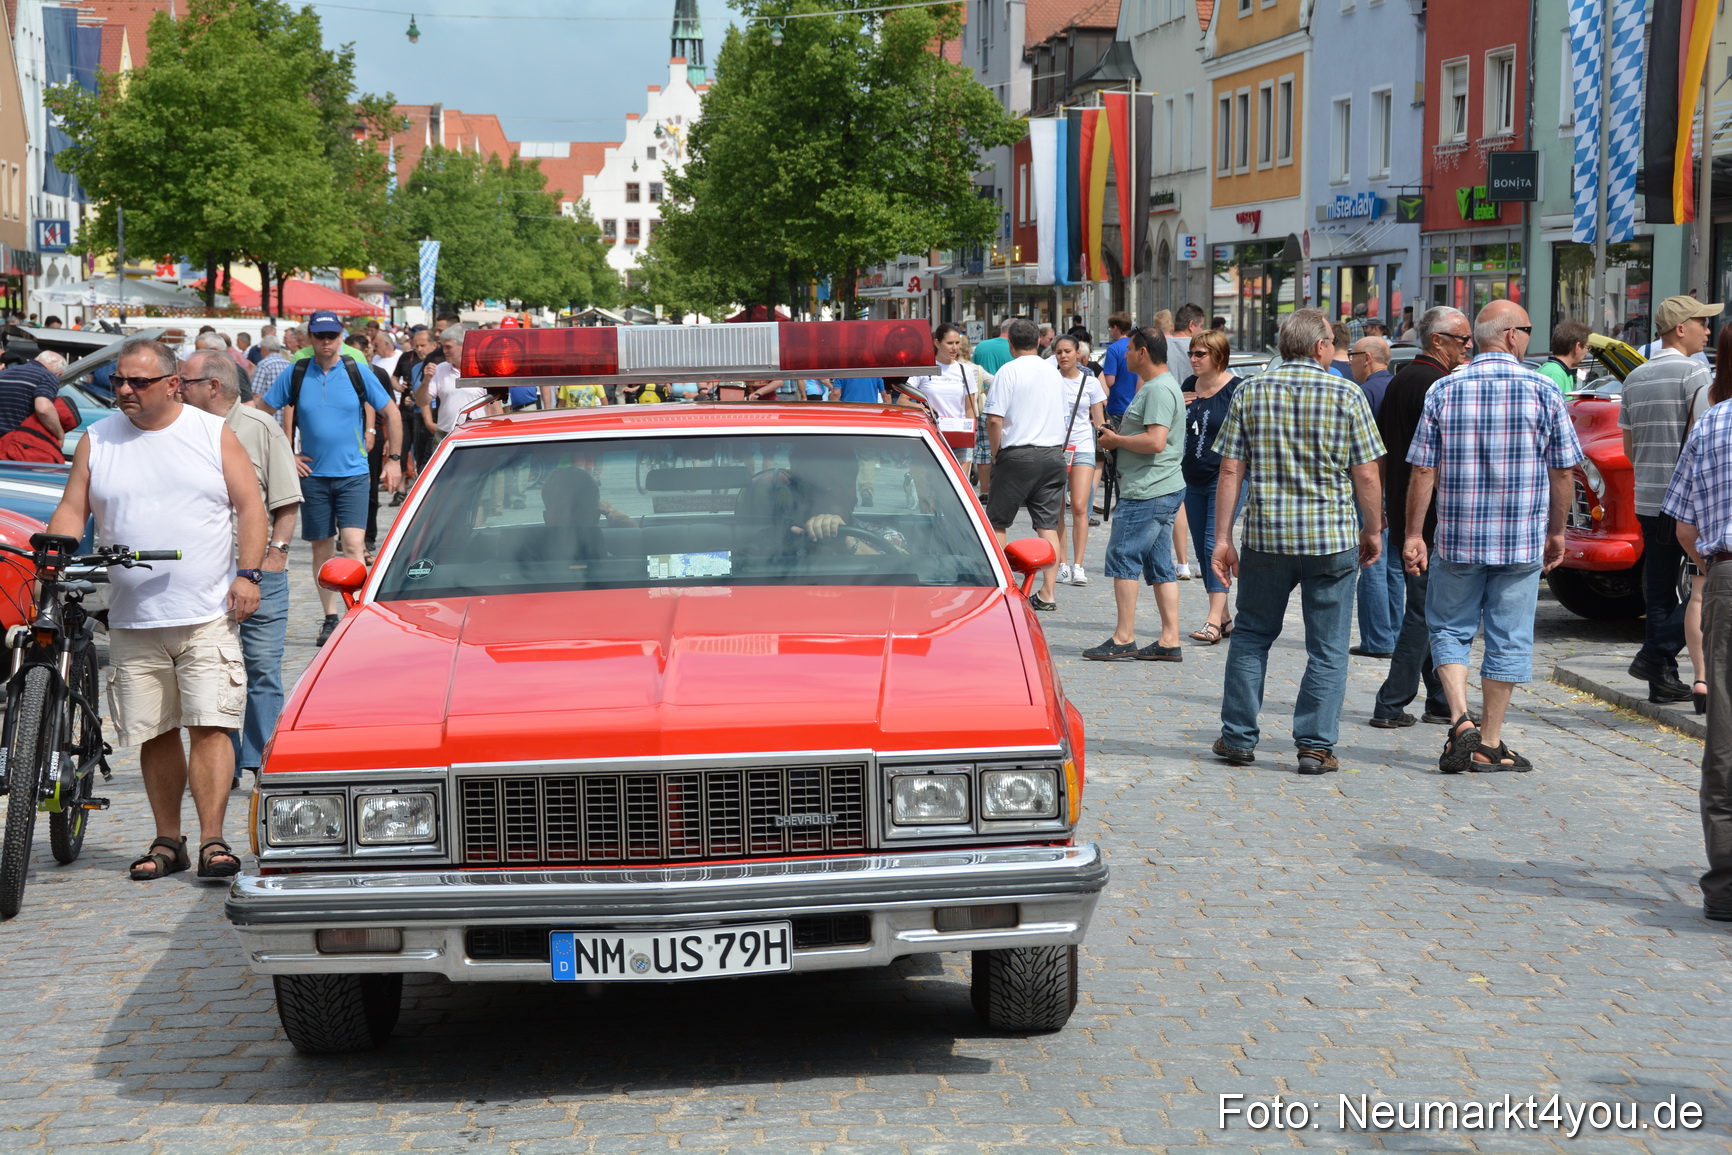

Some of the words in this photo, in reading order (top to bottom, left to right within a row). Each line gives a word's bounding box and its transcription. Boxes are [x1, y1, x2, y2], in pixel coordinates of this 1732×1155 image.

[775, 814, 838, 827] CHEVROLET
[560, 961, 569, 972] D
[575, 938, 625, 974] NM
